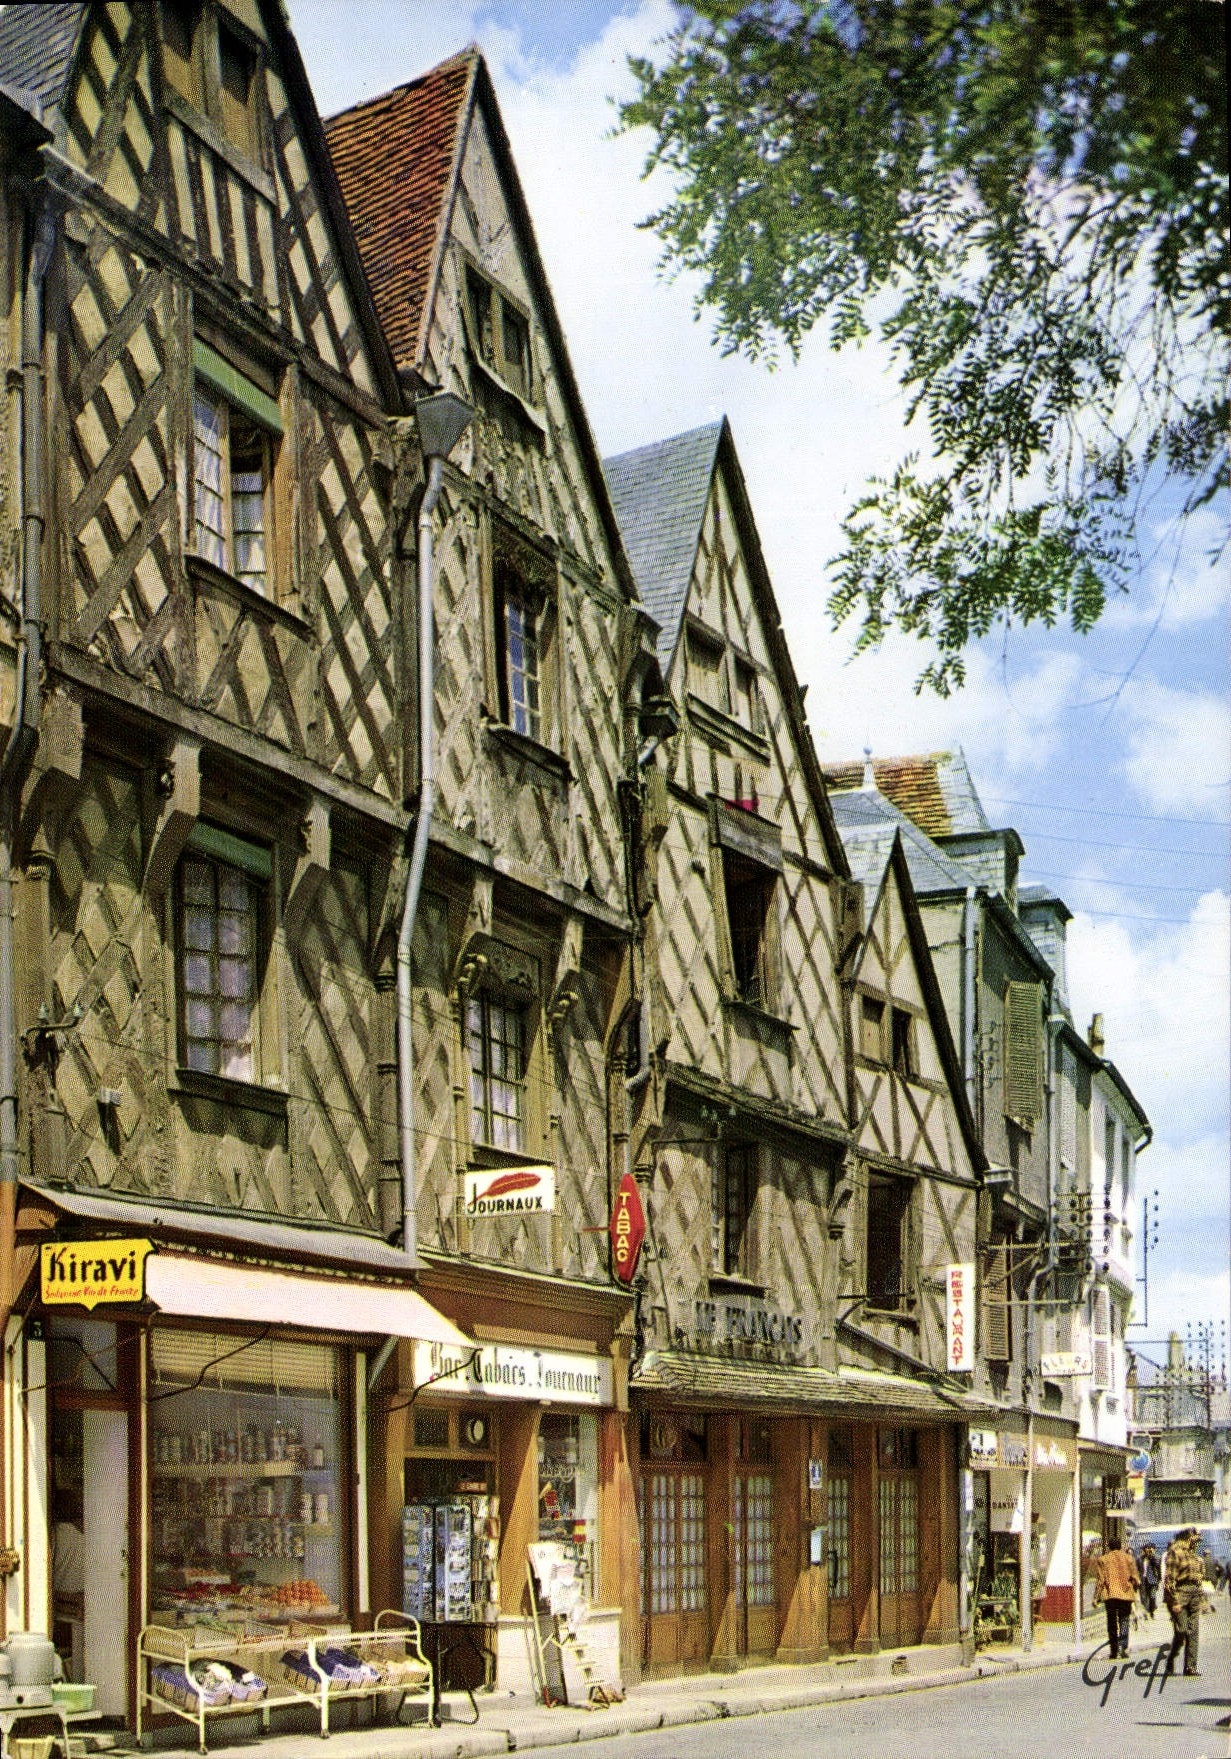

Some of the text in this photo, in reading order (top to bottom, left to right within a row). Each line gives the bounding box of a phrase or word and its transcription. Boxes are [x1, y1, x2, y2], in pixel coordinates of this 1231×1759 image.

[467, 1183, 542, 1214] JOURNAUX
[616, 1192, 632, 1262] TABAC
[46, 1246, 136, 1282] Kiravi
